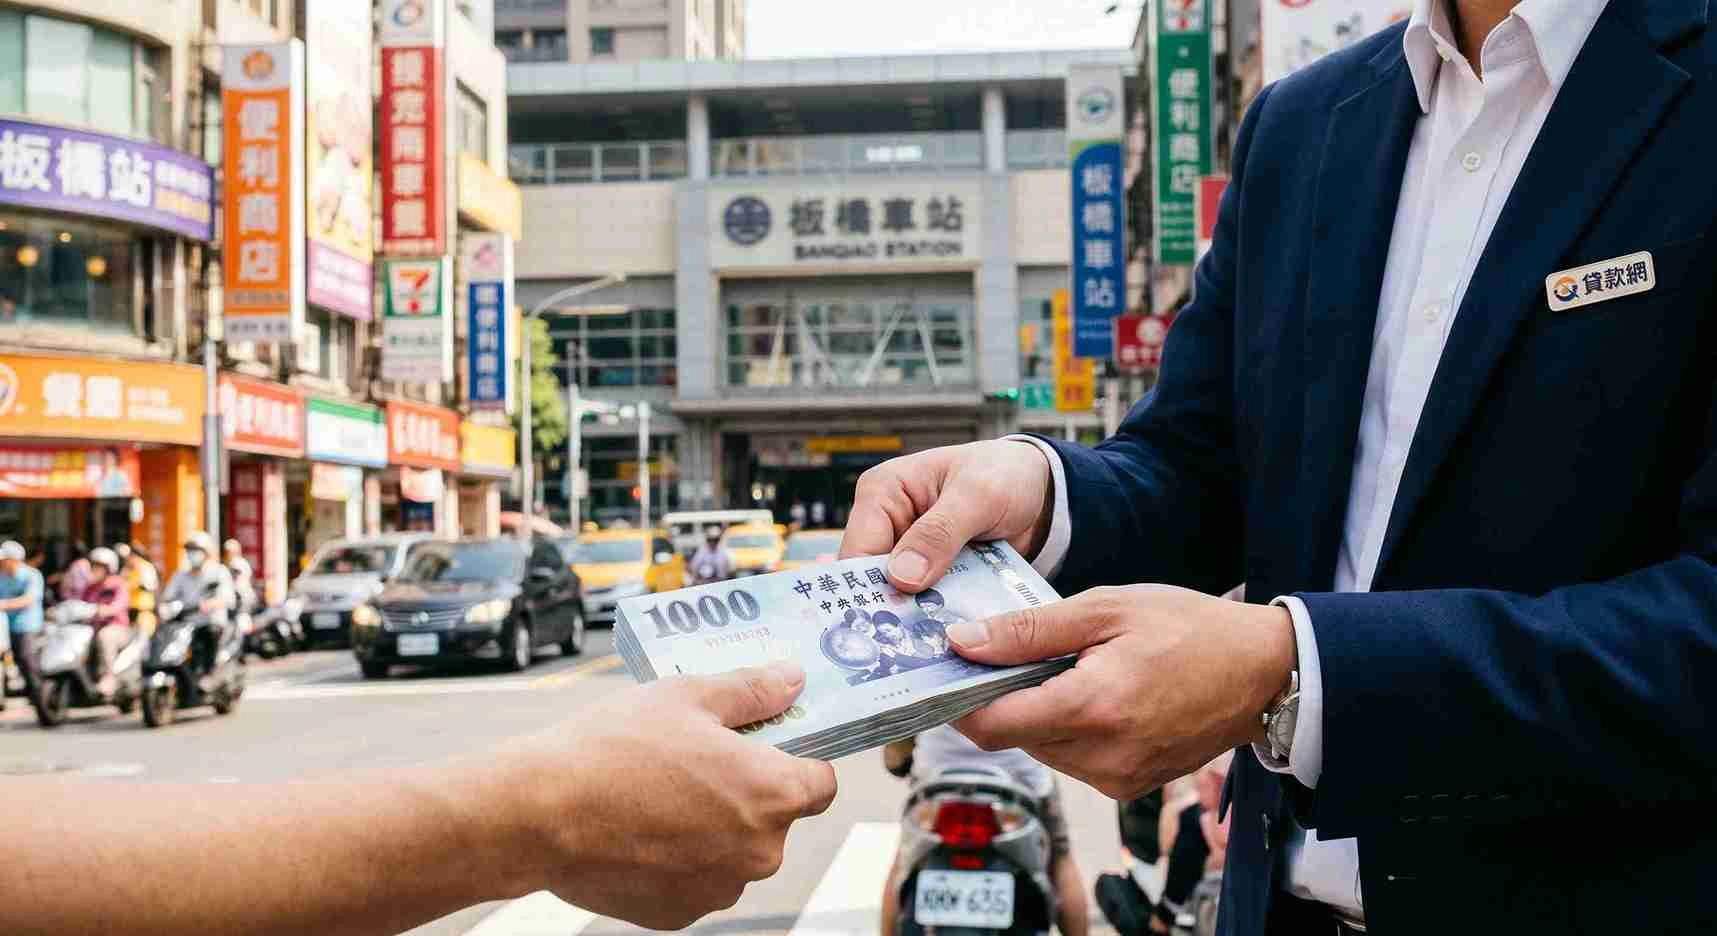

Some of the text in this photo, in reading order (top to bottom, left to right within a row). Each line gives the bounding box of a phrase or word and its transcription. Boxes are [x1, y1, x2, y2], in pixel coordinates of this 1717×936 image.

[0, 130, 153, 207] 板橋站
[239, 99, 279, 282] 便利商店
[788, 195, 965, 237] 板橋車站
[1081, 163, 1116, 308] 板橋車站
[1582, 261, 1648, 296] 貸款網
[792, 567, 889, 600] 中華民國
[819, 591, 886, 614] 中央銀行
[642, 589, 761, 639] 1000
